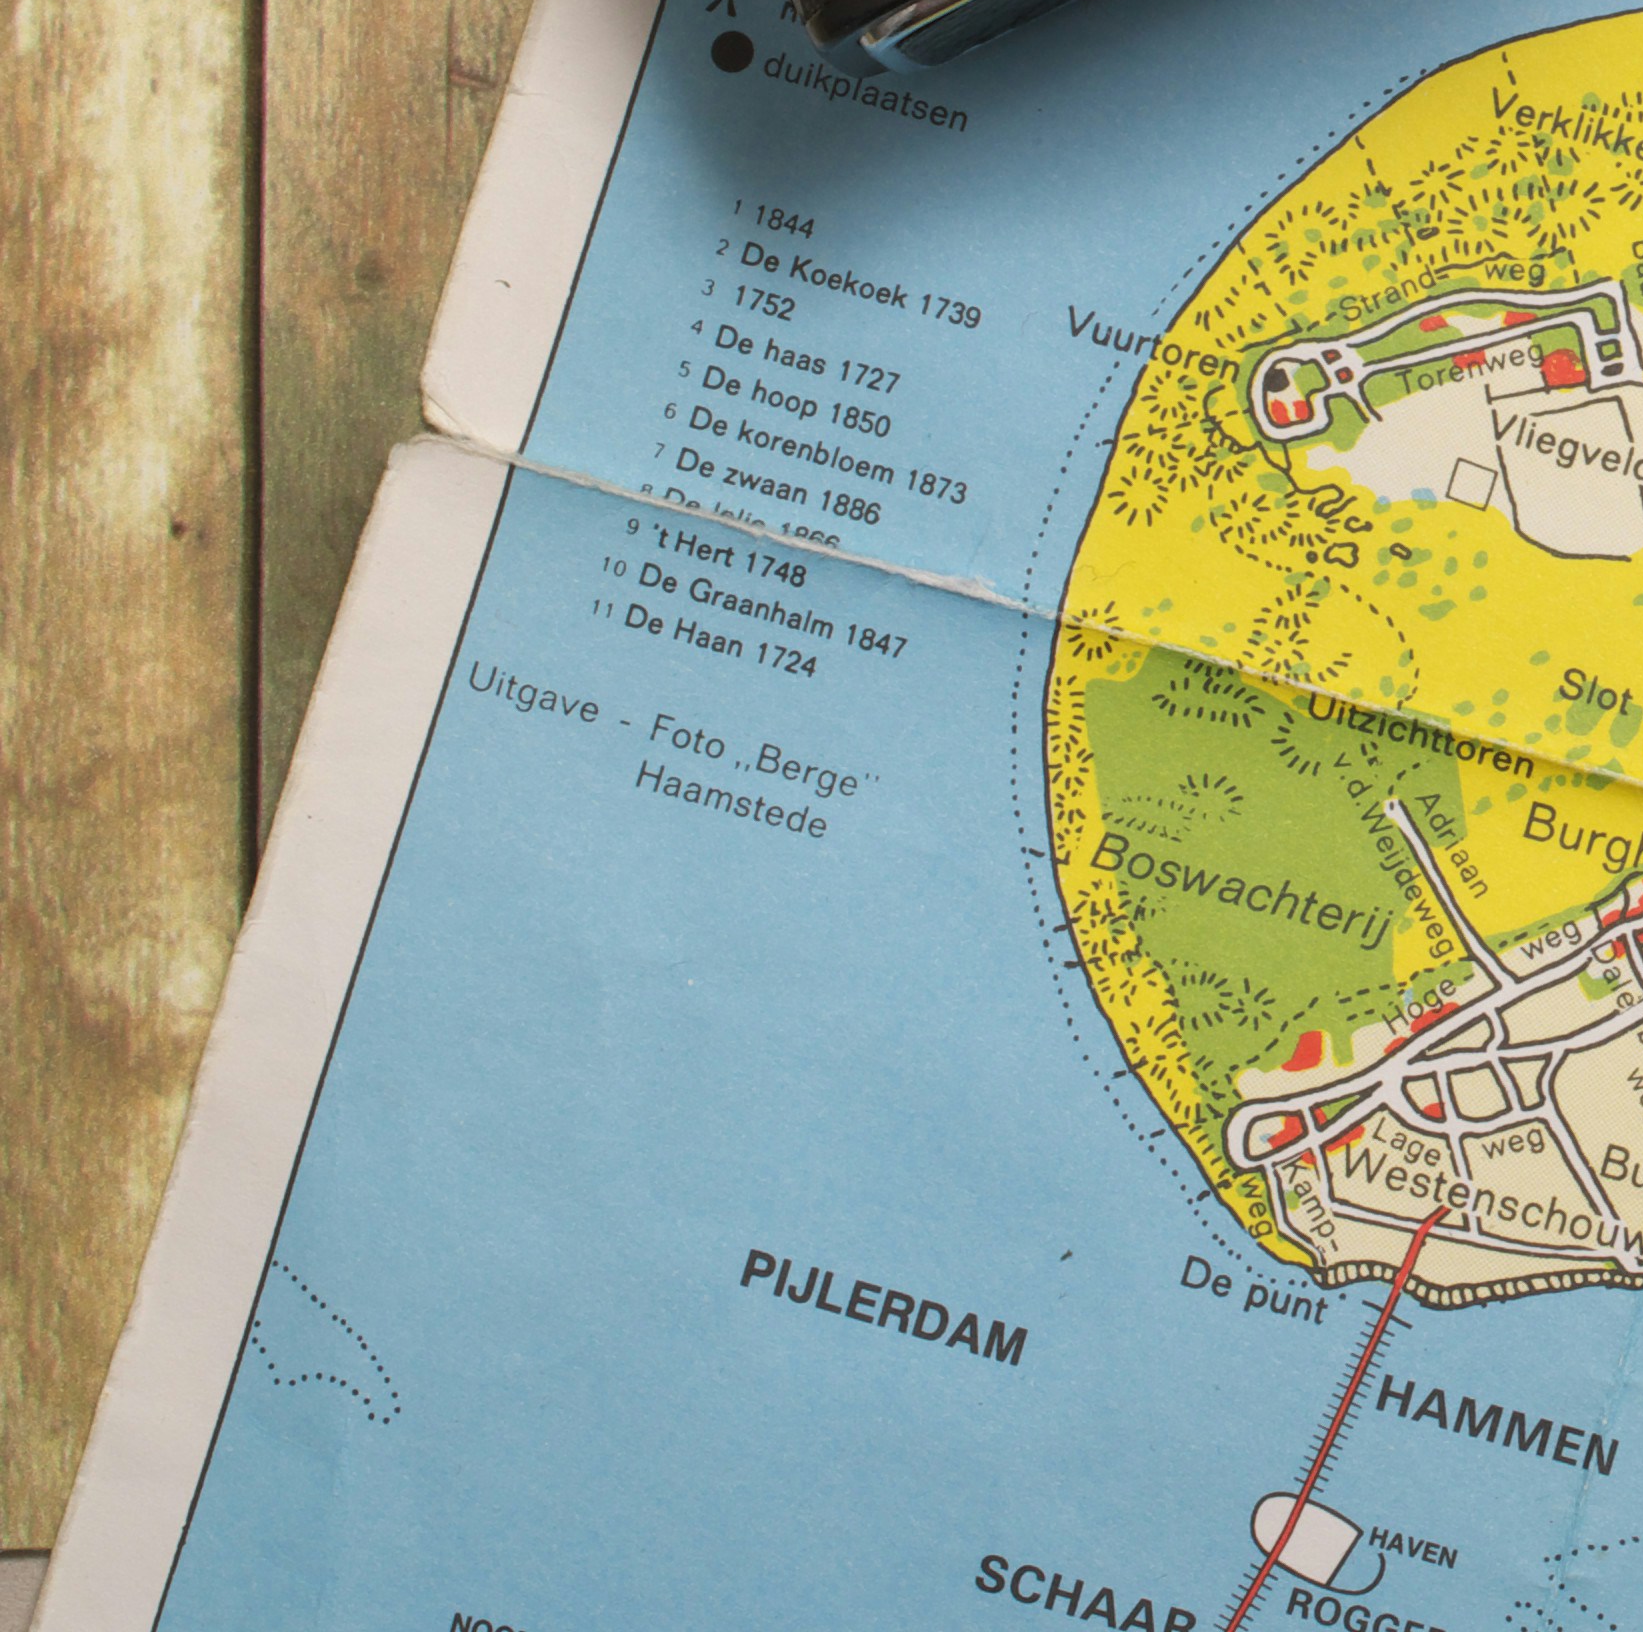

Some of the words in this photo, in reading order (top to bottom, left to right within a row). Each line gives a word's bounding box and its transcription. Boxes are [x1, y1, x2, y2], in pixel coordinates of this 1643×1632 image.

[762, 50, 970, 135] duikplaatsen
[755, 204, 816, 239] 1844
[700, 278, 716, 297] 3
[733, 284, 797, 322] 1752
[714, 238, 731, 258] 2
[740, 240, 783, 273] De
[789, 258, 909, 312] Koekoek
[920, 292, 984, 330] 1739
[689, 318, 704, 337] 4
[714, 323, 755, 356] De
[763, 336, 828, 377] haas
[839, 357, 902, 395] 1727
[1066, 304, 1241, 384] Vuurtoren
[1394, 340, 1547, 397] Torenweg
[677, 359, 691, 380] 5
[701, 365, 744, 397] De
[751, 376, 820, 420] hoop
[830, 401, 893, 438] 1850
[652, 442, 667, 461] 7
[676, 447, 717, 479] De
[723, 465, 810, 506] zwaan
[819, 488, 883, 526] 1886
[663, 402, 678, 421] 6
[689, 405, 730, 437] De
[736, 419, 897, 487] korenbloem
[906, 466, 969, 506] 1873
[625, 516, 640, 536] 9
[674, 527, 738, 570] Hert
[745, 548, 809, 588] 1748
[601, 556, 627, 577] 10
[638, 559, 681, 595] De
[687, 576, 836, 639] Graanhalm
[846, 620, 909, 659] 1847
[625, 602, 665, 635] De
[673, 615, 744, 657] Haan
[755, 641, 818, 678] 1724
[467, 659, 602, 725] Uitgave
[649, 712, 727, 762] Foto
[1558, 666, 1635, 717] Slot
[1306, 689, 1536, 780] Uitzichttoren
[635, 759, 830, 841] Haamstede
[1089, 829, 1398, 952] Boswachterij
[738, 1248, 1029, 1368] PIJLERDAM
[1180, 1255, 1233, 1298] De
[1243, 1283, 1329, 1327] punt
[1375, 1373, 1620, 1477] HAMMEN
[1368, 1525, 1458, 1570] HAVEN
